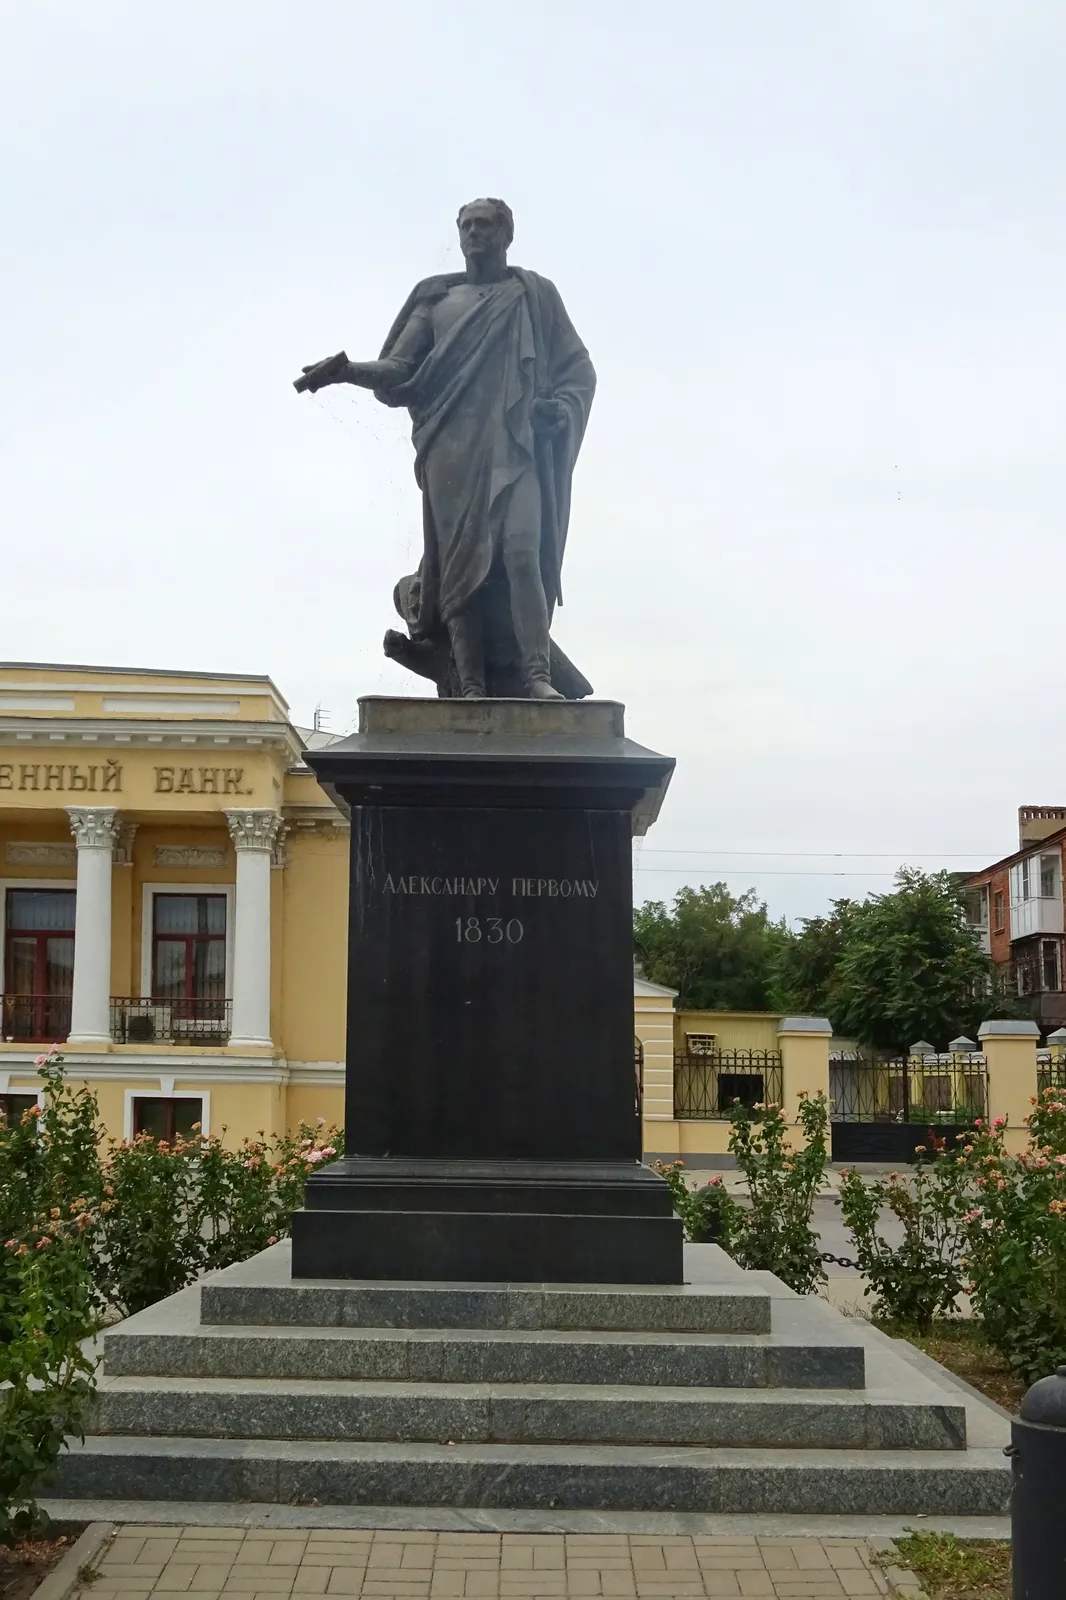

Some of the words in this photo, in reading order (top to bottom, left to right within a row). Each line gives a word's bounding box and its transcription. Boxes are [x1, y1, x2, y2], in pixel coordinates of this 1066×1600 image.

[0, 758, 123, 792] ЕННЫЙ
[154, 766, 254, 795] БАНК.
[382, 873, 500, 896] АЛЕКСАНДРУ
[512, 877, 599, 898] ПЕРВОМУ
[455, 916, 524, 943] 1830
